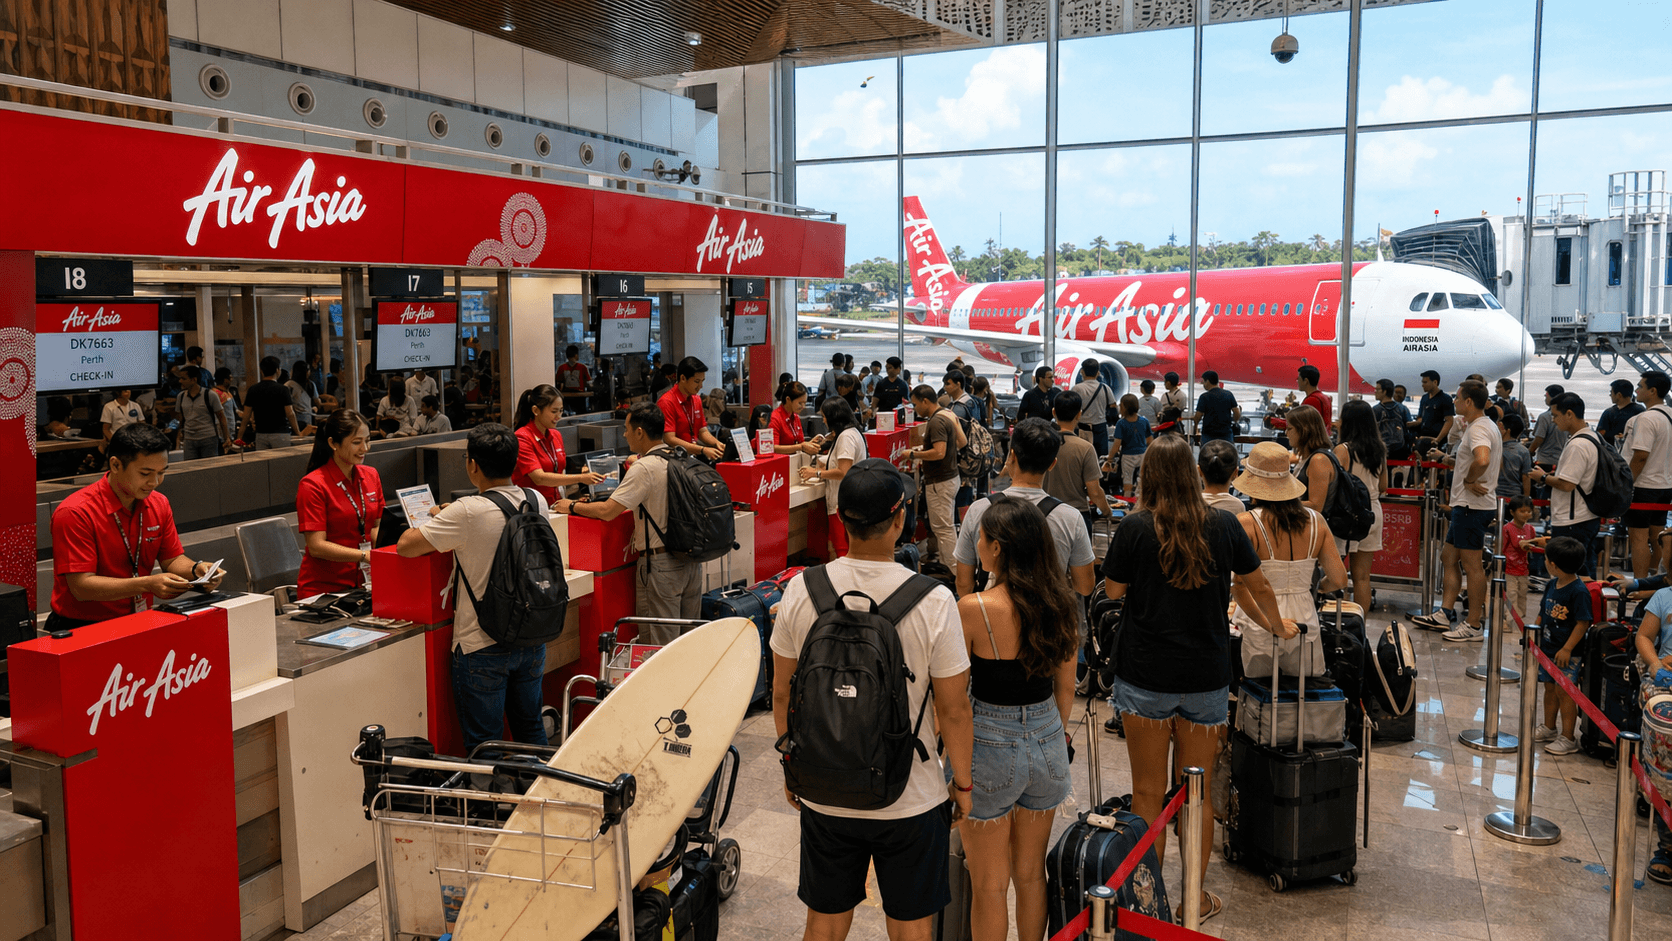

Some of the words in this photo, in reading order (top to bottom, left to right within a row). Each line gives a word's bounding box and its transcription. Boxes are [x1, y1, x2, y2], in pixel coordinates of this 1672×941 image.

[183, 147, 272, 246] Air
[266, 158, 367, 249] Asia
[697, 214, 729, 272] Air
[726, 218, 764, 274] Asia
[903, 212, 932, 255] Air
[64, 267, 87, 290] 18
[408, 274, 420, 292] 17
[620, 279, 628, 293] 16
[747, 282, 753, 294] 15
[917, 259, 953, 316] Asia
[62, 306, 90, 332] Air
[87, 306, 121, 332] Asia
[400, 304, 416, 324] Air
[415, 304, 435, 324] Asia
[1015, 282, 1094, 341] Air
[1089, 281, 1214, 345] Asia
[405, 328, 431, 338] DK7663
[70, 338, 114, 350] DK7663
[1403, 344, 1438, 352] AIRASIA
[81, 355, 104, 364] Perth
[70, 371, 114, 382] CHECK-IN
[756, 474, 769, 504] Air
[767, 471, 784, 498] Asia
[87, 663, 146, 736] Air
[143, 649, 212, 719] Asia
